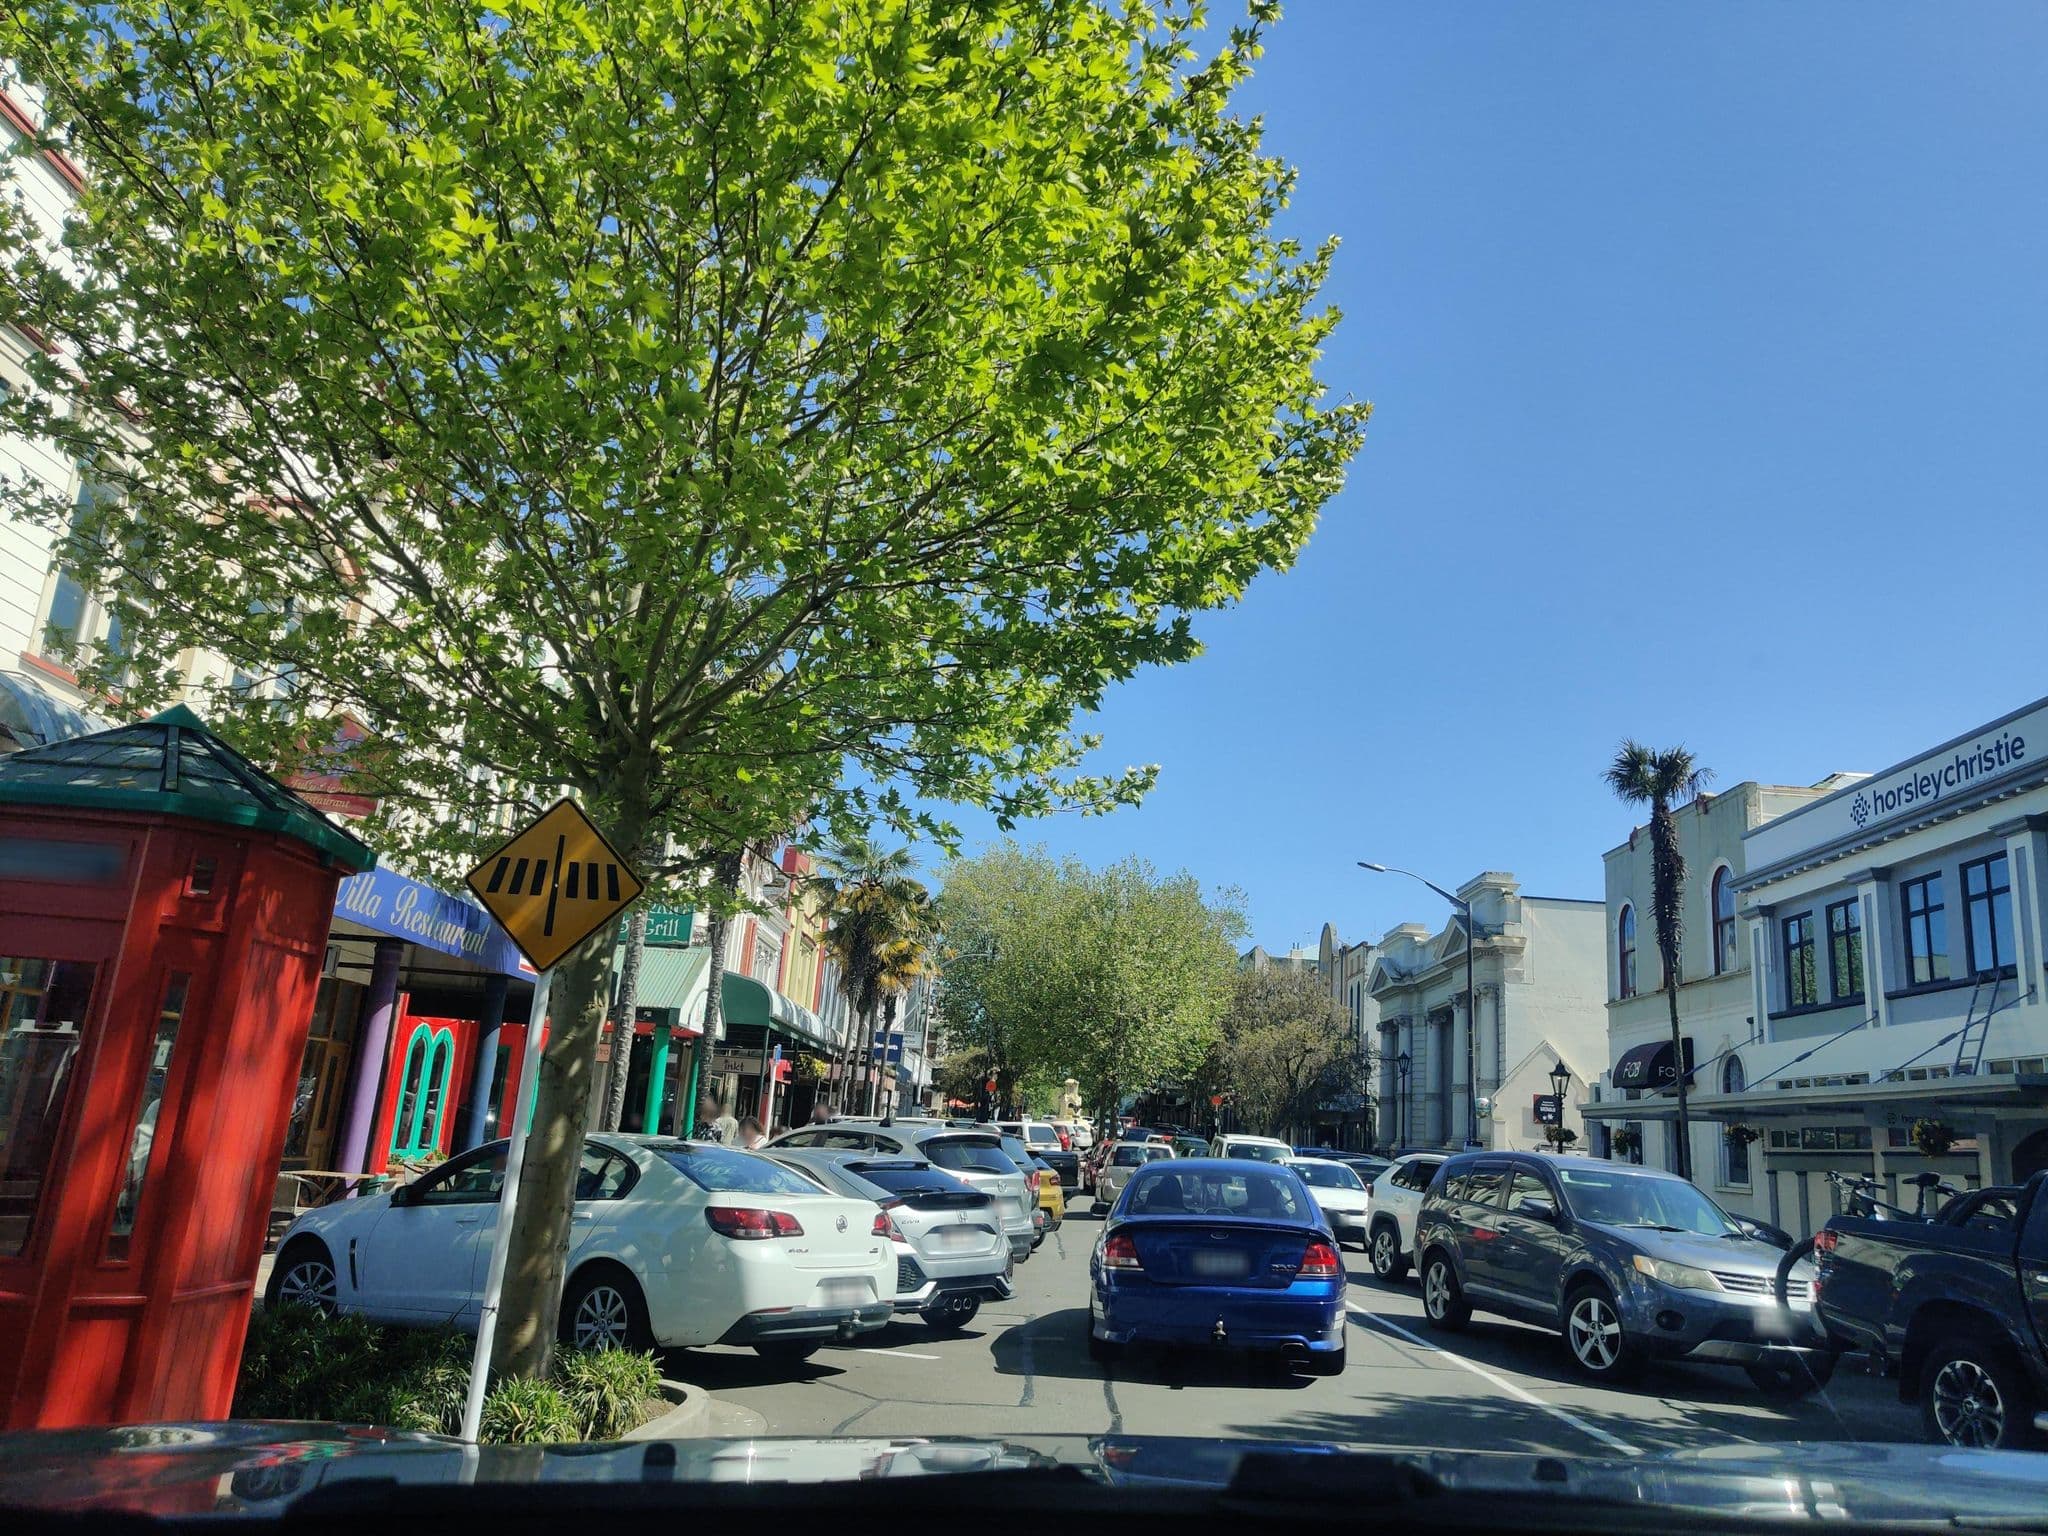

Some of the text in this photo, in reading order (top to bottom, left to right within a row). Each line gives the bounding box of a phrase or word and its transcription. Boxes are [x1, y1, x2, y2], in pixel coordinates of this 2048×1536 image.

[1872, 732, 2026, 816] horsleychristie
[390, 885, 491, 955] Restaurant
[644, 918, 679, 937] Grill
[1622, 1061, 1642, 1079] FOB
[1658, 1066, 1676, 1078] FO
